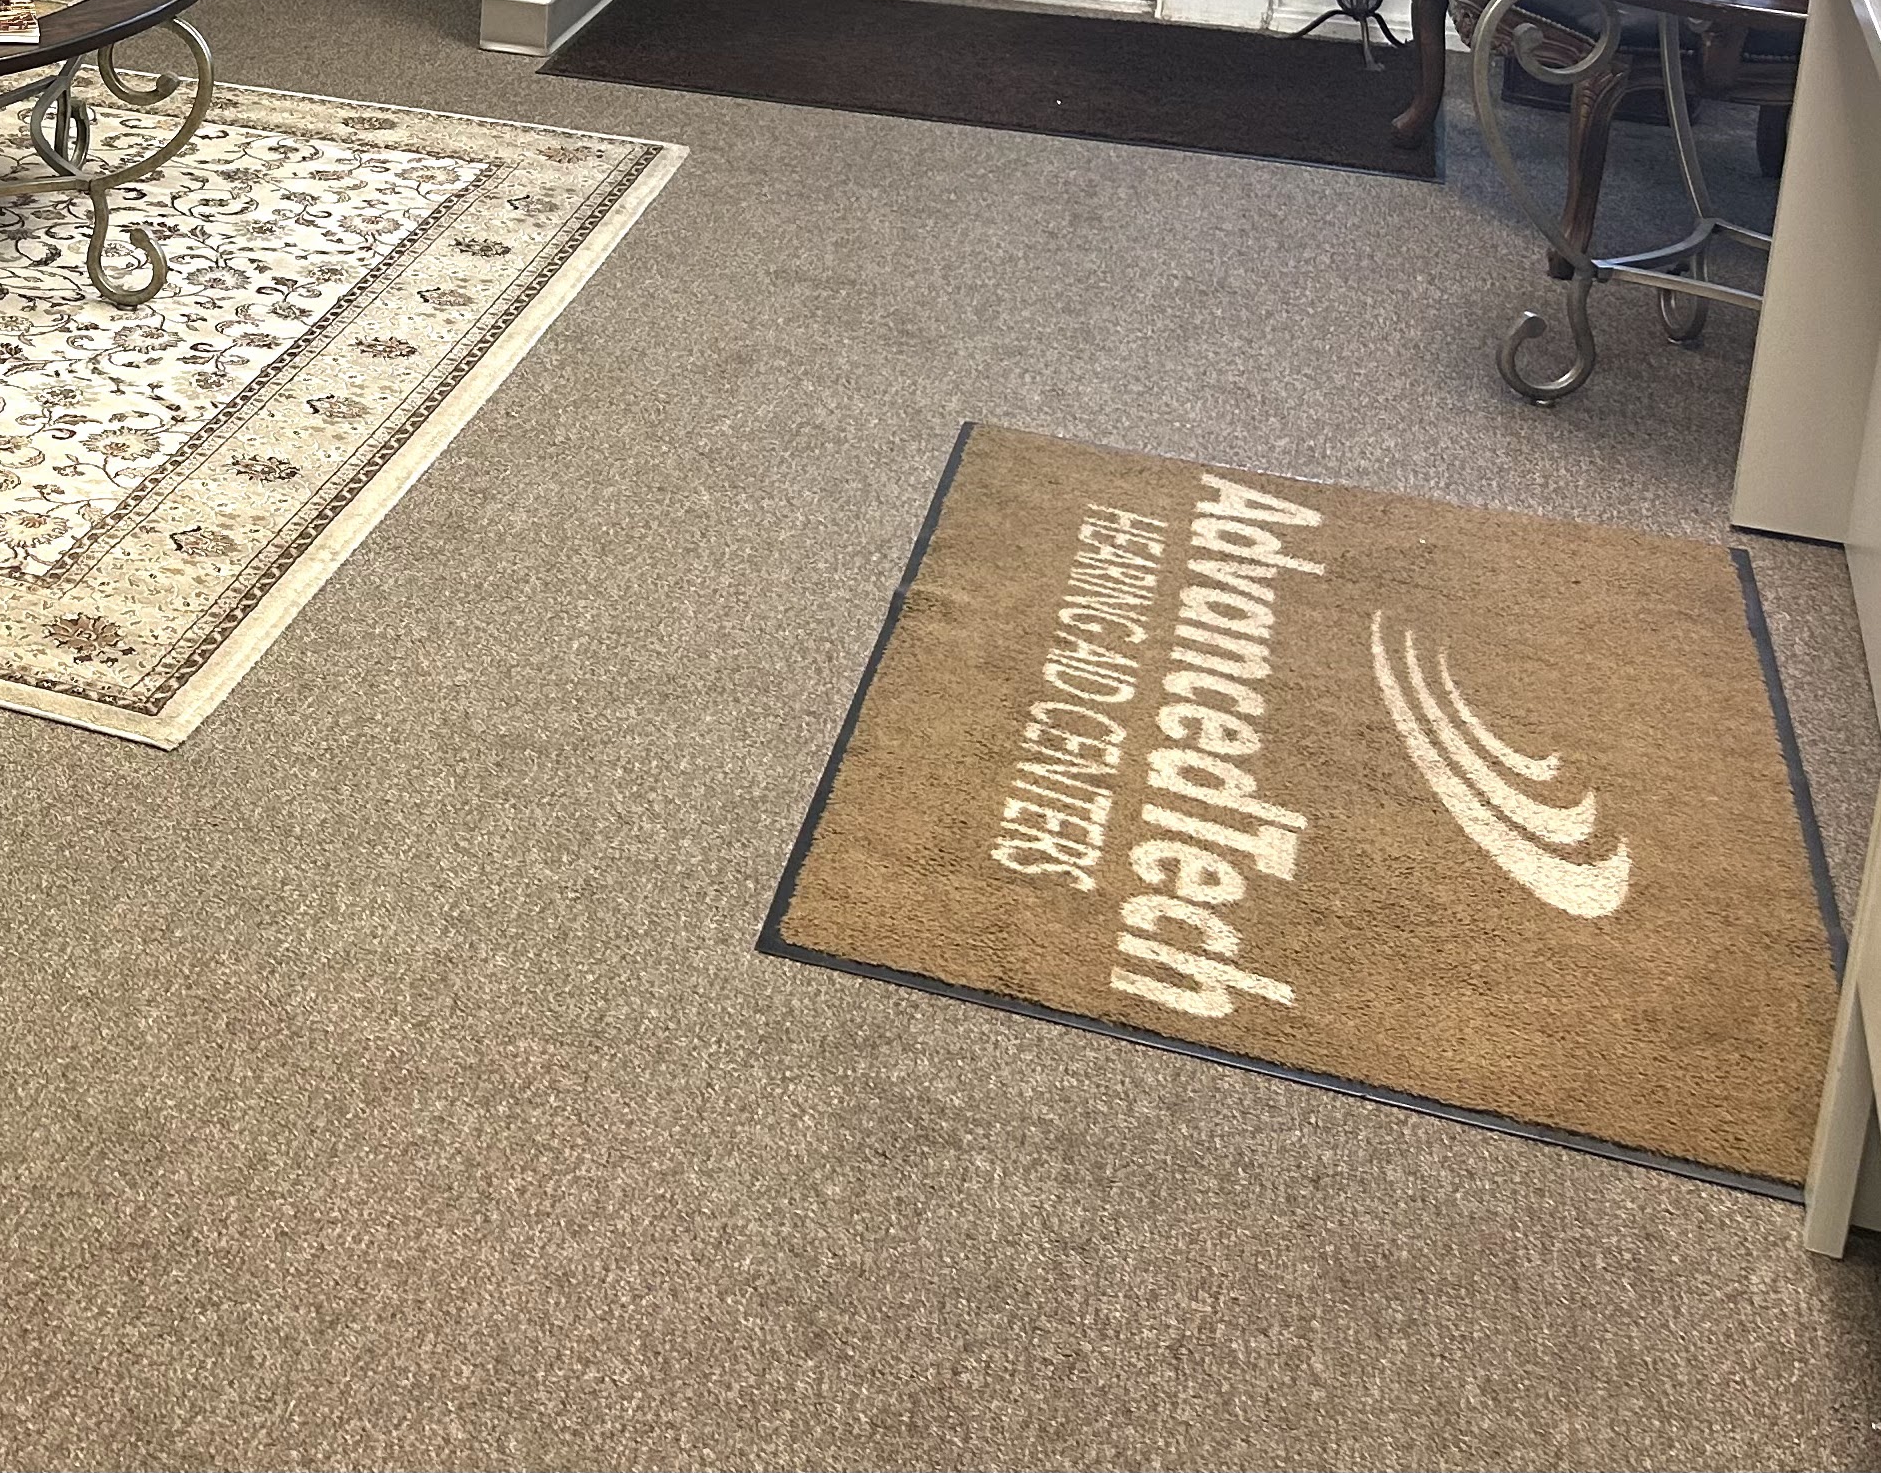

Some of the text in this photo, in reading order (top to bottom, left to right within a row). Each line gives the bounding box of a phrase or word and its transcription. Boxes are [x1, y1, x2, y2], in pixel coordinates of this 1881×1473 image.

[991, 503, 1169, 892] HEARING AID CENTERS
[1110, 473, 1326, 1018] AdvancedTech
